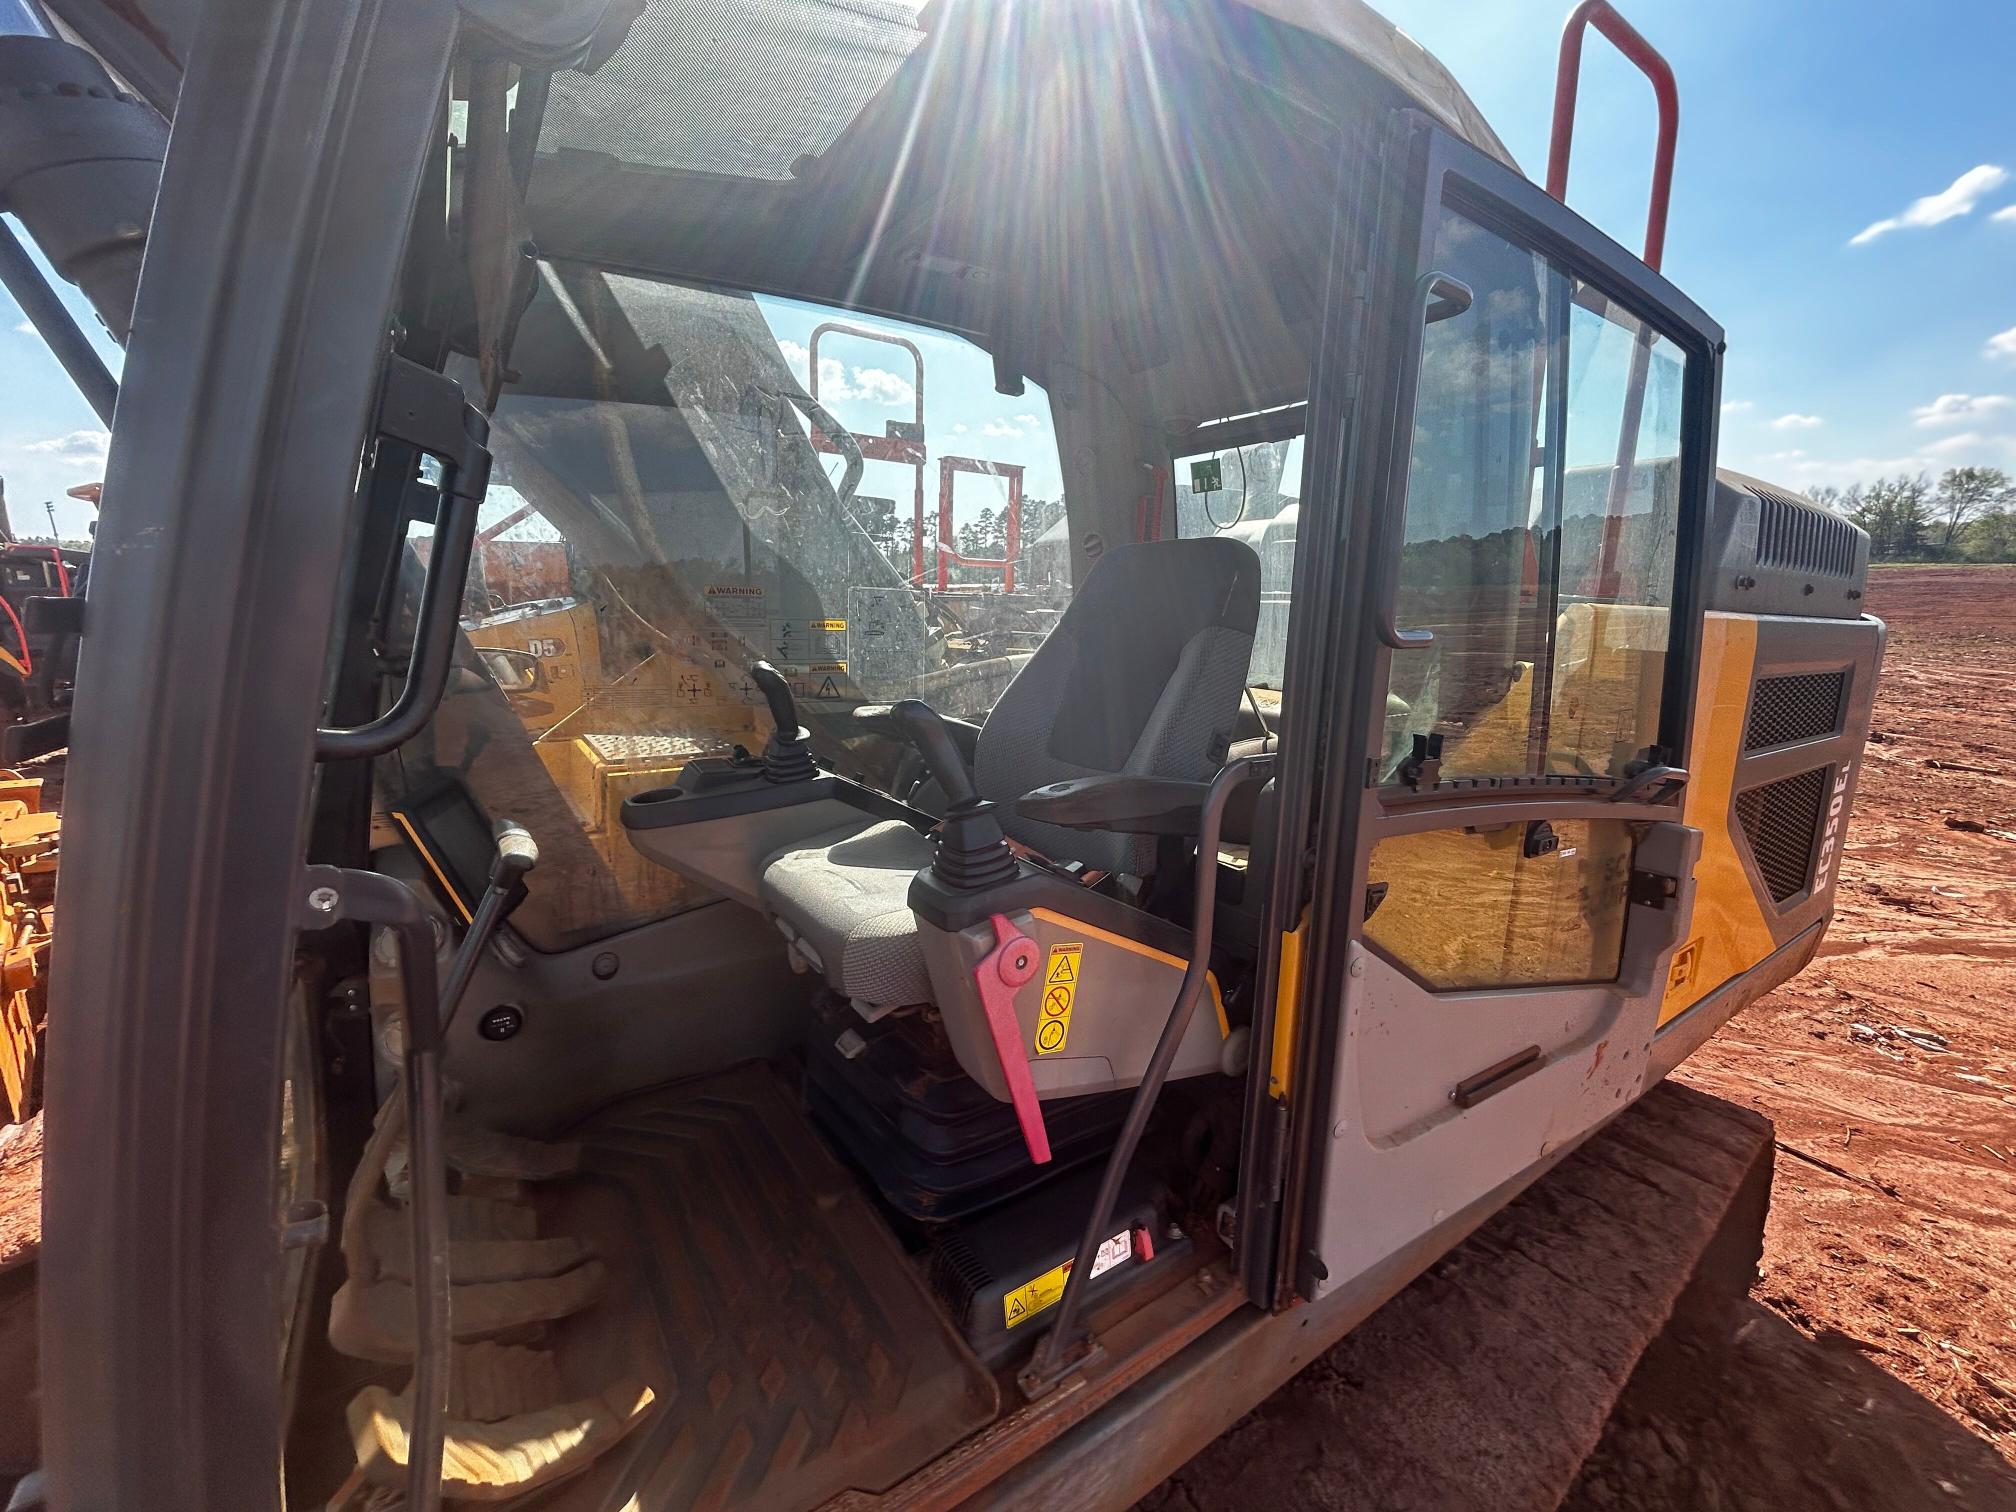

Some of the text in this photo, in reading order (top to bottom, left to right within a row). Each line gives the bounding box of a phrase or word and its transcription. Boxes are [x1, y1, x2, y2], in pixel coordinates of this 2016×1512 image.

[717, 587, 762, 596] WARNING
[528, 639, 555, 658] D5
[1813, 760, 1851, 895] EC350EL
